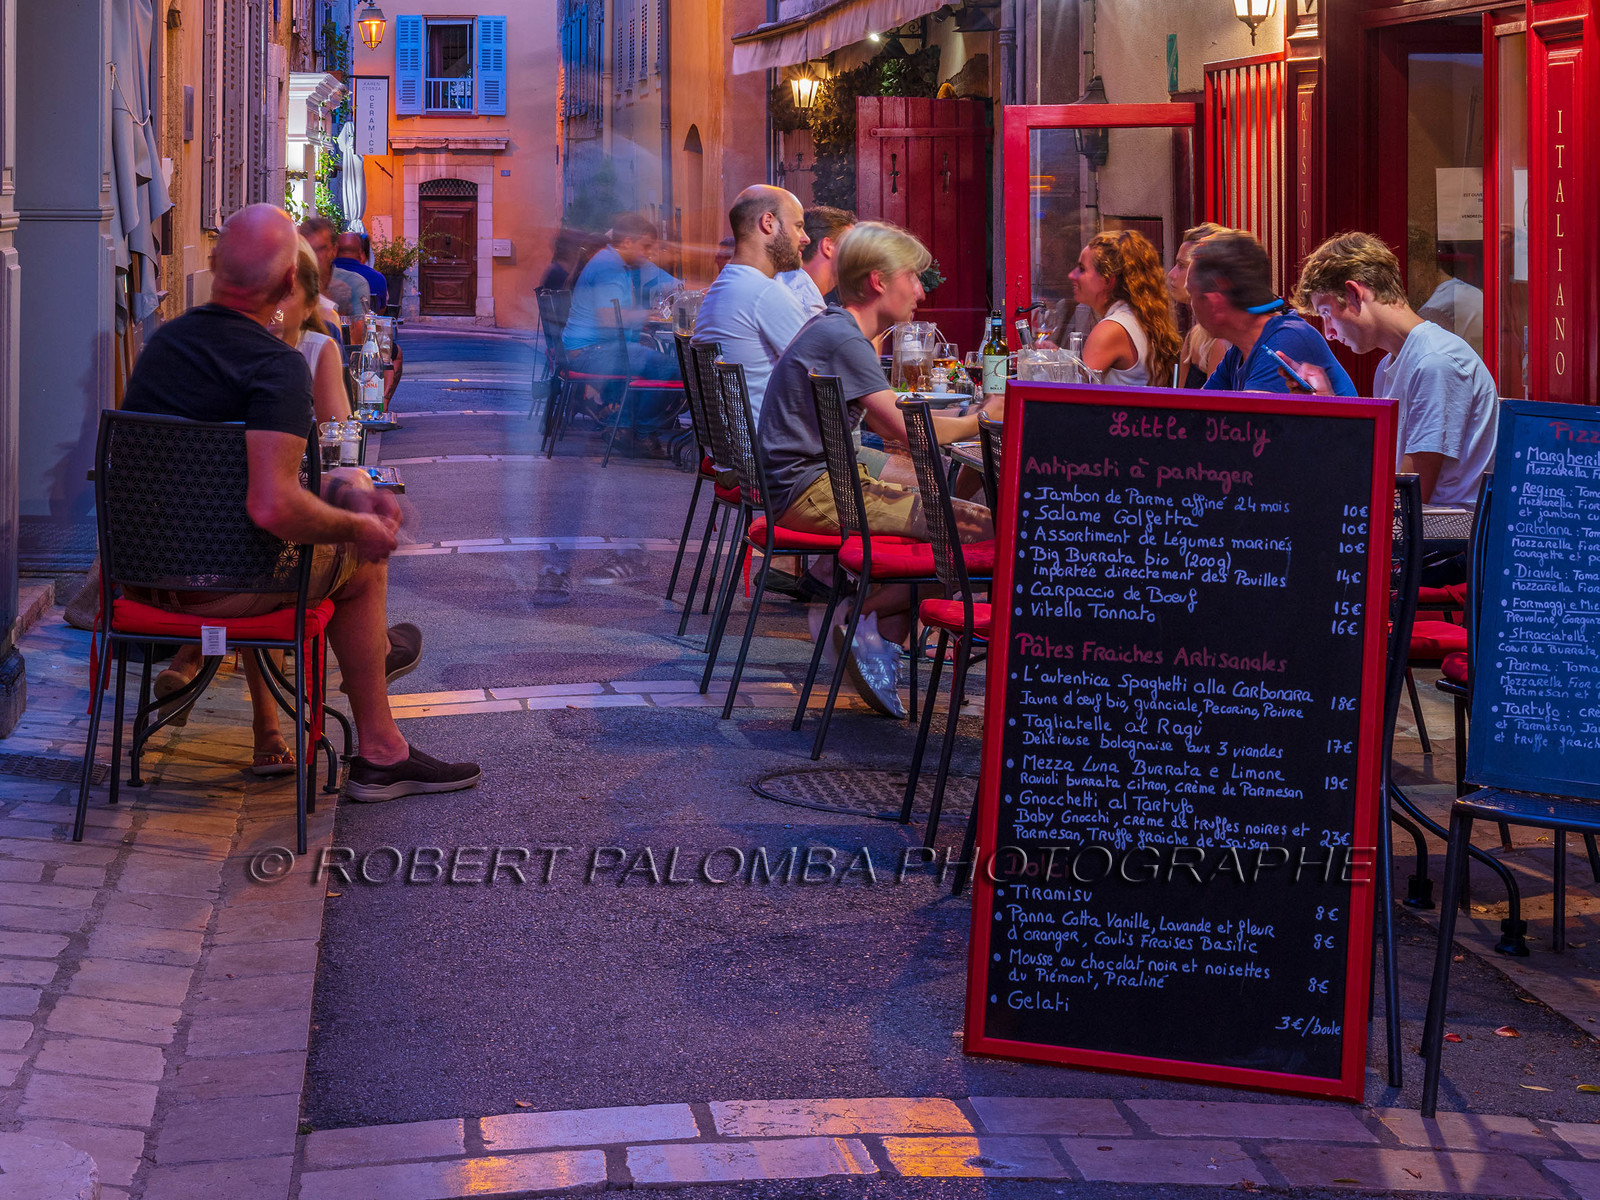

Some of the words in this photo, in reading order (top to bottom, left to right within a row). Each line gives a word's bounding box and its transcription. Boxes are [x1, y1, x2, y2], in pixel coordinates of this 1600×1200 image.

[1554, 109, 1567, 376] ITALIANO
[1110, 412, 1187, 439] Little
[1207, 418, 1270, 457] Italy
[1025, 456, 1118, 481] Antipasti
[1130, 458, 1149, 477] à
[1157, 462, 1253, 494] partager
[1034, 484, 1099, 502] Jambon
[1105, 489, 1121, 504] de
[1125, 488, 1173, 506] Parme
[1182, 494, 1227, 517] affiné
[1235, 497, 1256, 512] 24
[1261, 503, 1289, 512] mois
[1344, 505, 1368, 517] 10€
[1035, 504, 1100, 522] Salame
[1114, 506, 1202, 531] Golfetta
[1342, 523, 1366, 535] 10€
[1030, 546, 1063, 568] Big
[1065, 547, 1135, 566] Burrata
[1145, 549, 1169, 565] bio
[1035, 526, 1130, 543] Assortiment
[1139, 528, 1156, 545] de
[1164, 531, 1224, 559] Légumes
[1231, 537, 1291, 551] marinés
[1340, 542, 1365, 553] 10€
[1034, 561, 1096, 582] importée
[1105, 564, 1194, 580] directement
[1201, 564, 1228, 582] des
[1234, 570, 1286, 587] Pouilles
[1337, 569, 1361, 584] 14€
[1031, 581, 1114, 605] Carpaccio
[1124, 585, 1141, 600] de
[1335, 602, 1361, 615] 15€
[1032, 599, 1081, 618] Vitello
[1088, 604, 1155, 622] Tonnato
[1332, 620, 1357, 635] 16€
[1015, 633, 1073, 658] Pâtes
[1083, 642, 1162, 663] Fraiches
[1174, 647, 1286, 672] Artisanales
[1024, 664, 1110, 687] L'autentica
[1118, 674, 1186, 701] Spaghetti
[1194, 679, 1226, 694] alla
[1233, 681, 1313, 702] Carbonara
[1331, 697, 1356, 710] 18€
[1020, 691, 1058, 704] Jaune
[1106, 692, 1128, 713] bio,
[1203, 699, 1259, 720] Pecorino,
[1263, 703, 1303, 718] Poivre
[1023, 714, 1112, 736] Tagliatelle
[1125, 717, 1147, 734] al
[1023, 730, 1090, 745] Délicieuse
[1100, 733, 1173, 760] bolognaise
[1217, 742, 1228, 755] 3
[1233, 744, 1283, 758] viandes
[1327, 740, 1352, 753] 17€
[1021, 771, 1058, 784] Ravioli
[1067, 774, 1120, 788] burrata
[1127, 777, 1170, 795] citron,
[1175, 780, 1216, 794] crème
[1222, 782, 1236, 796] de
[1240, 782, 1303, 799] Parmesan
[1023, 755, 1074, 771] Mezza
[1082, 756, 1119, 773] Luna
[1132, 760, 1201, 776] Burrata
[1232, 763, 1285, 781] Limone
[1325, 776, 1348, 790] 19€
[1020, 790, 1097, 807] Gnocchetti
[1109, 793, 1126, 810] al
[1132, 796, 1193, 822] Tartufo
[1013, 824, 1084, 845] Parmesan,
[1087, 828, 1133, 850] Truffe
[1138, 830, 1188, 850] fraiche
[1196, 833, 1214, 848] de
[1220, 837, 1269, 852] saison
[1320, 830, 1350, 847] 23€
[1015, 807, 1054, 827] Baby
[1123, 812, 1164, 827] crème
[1171, 813, 1188, 828] de
[1194, 816, 1240, 840] truffes
[1246, 824, 1287, 835] noires
[1292, 823, 1310, 836] et
[1010, 885, 1092, 902] Tiramisu
[1007, 904, 1055, 923] Panna
[1062, 909, 1101, 927] Cotta
[1107, 912, 1155, 934] Vanille,
[1160, 916, 1211, 932] Lavande
[1217, 920, 1232, 934] et
[1237, 919, 1275, 941] fleur
[1094, 930, 1133, 946] Coulis
[1141, 934, 1193, 950] Fraises
[1200, 936, 1257, 953] Basilic
[1009, 968, 1027, 981] du
[1035, 968, 1098, 990] Piémont,
[1103, 971, 1169, 988] Praliné
[1010, 949, 1052, 966] Mousse
[1061, 957, 1075, 967] au
[1081, 953, 1144, 970] chocolat
[1148, 960, 1177, 971] noir
[1182, 958, 1198, 972] et
[1205, 962, 1270, 979] noisettes
[1008, 990, 1069, 1011] Gelati
